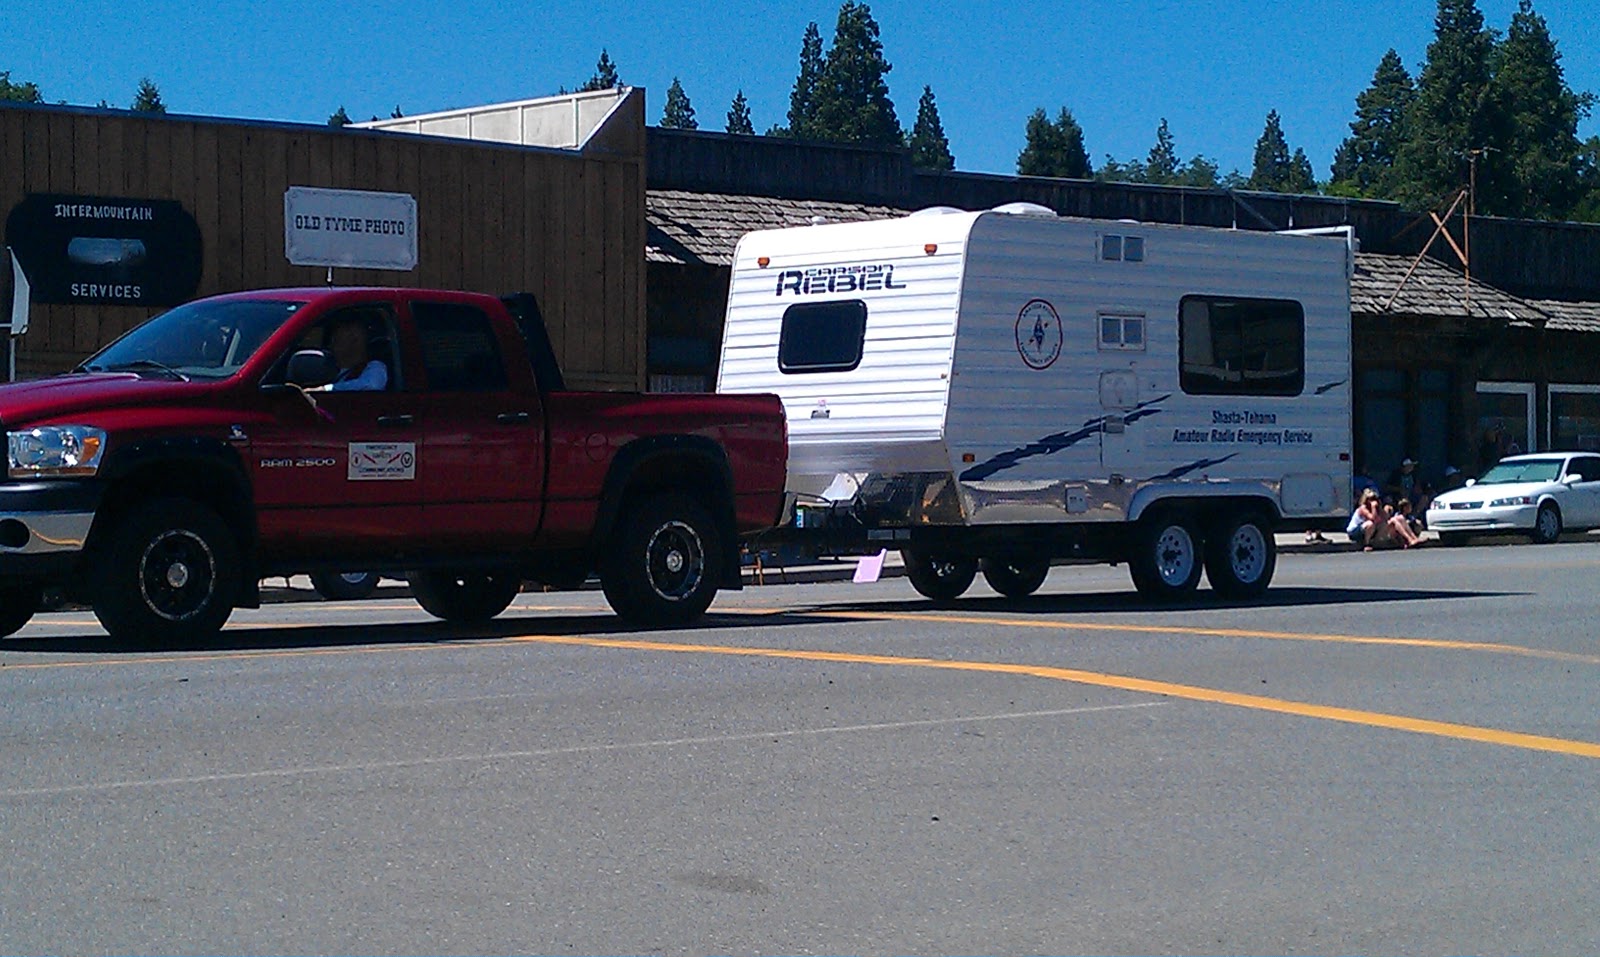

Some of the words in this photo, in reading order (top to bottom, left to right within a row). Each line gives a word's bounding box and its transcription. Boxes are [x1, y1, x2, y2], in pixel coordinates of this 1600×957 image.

[54, 204, 152, 220] INTERMOUNTAIN
[295, 215, 320, 230] OLD
[324, 217, 362, 232] TYME
[365, 219, 405, 235] PHOTO
[71, 283, 141, 298] SERVICES
[776, 271, 907, 296] REBEL
[1173, 429, 1209, 443] Amateur
[1211, 429, 1235, 443] Radio
[1237, 429, 1281, 446] Emergency
[1284, 429, 1313, 443] Service
[260, 459, 293, 468] RAM
[296, 458, 336, 467] 2500
